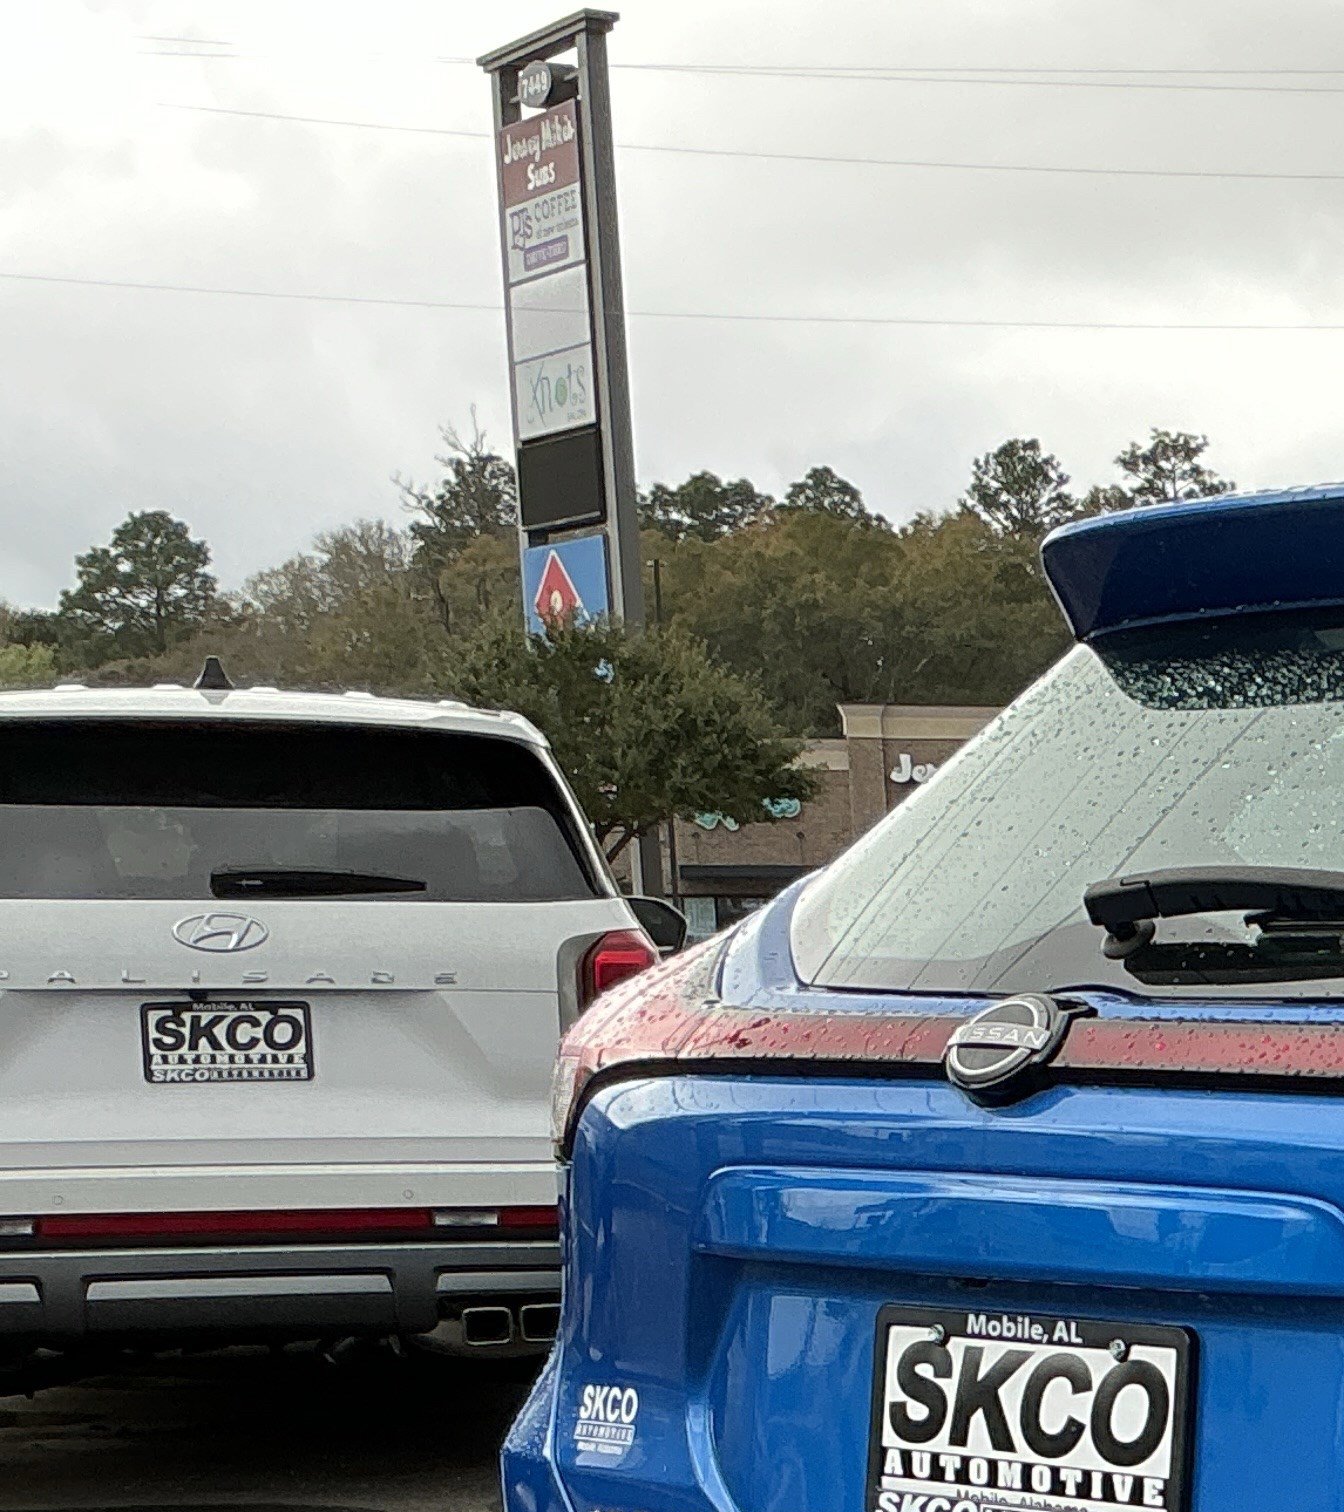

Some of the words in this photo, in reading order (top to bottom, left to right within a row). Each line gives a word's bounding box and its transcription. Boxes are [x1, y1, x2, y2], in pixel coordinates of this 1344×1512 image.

[152, 1014, 303, 1052] SKCO
[960, 1025, 1048, 1047] SSAN
[151, 1053, 305, 1065] AUTOMOTIVE
[151, 1068, 210, 1082] SKCO
[965, 1313, 1049, 1344] Mobile,
[1052, 1319, 1084, 1344] AL
[578, 1384, 639, 1423] SKCO
[888, 1339, 1170, 1467] SKCO
[883, 1448, 1165, 1507] AUTOMOTIVE
